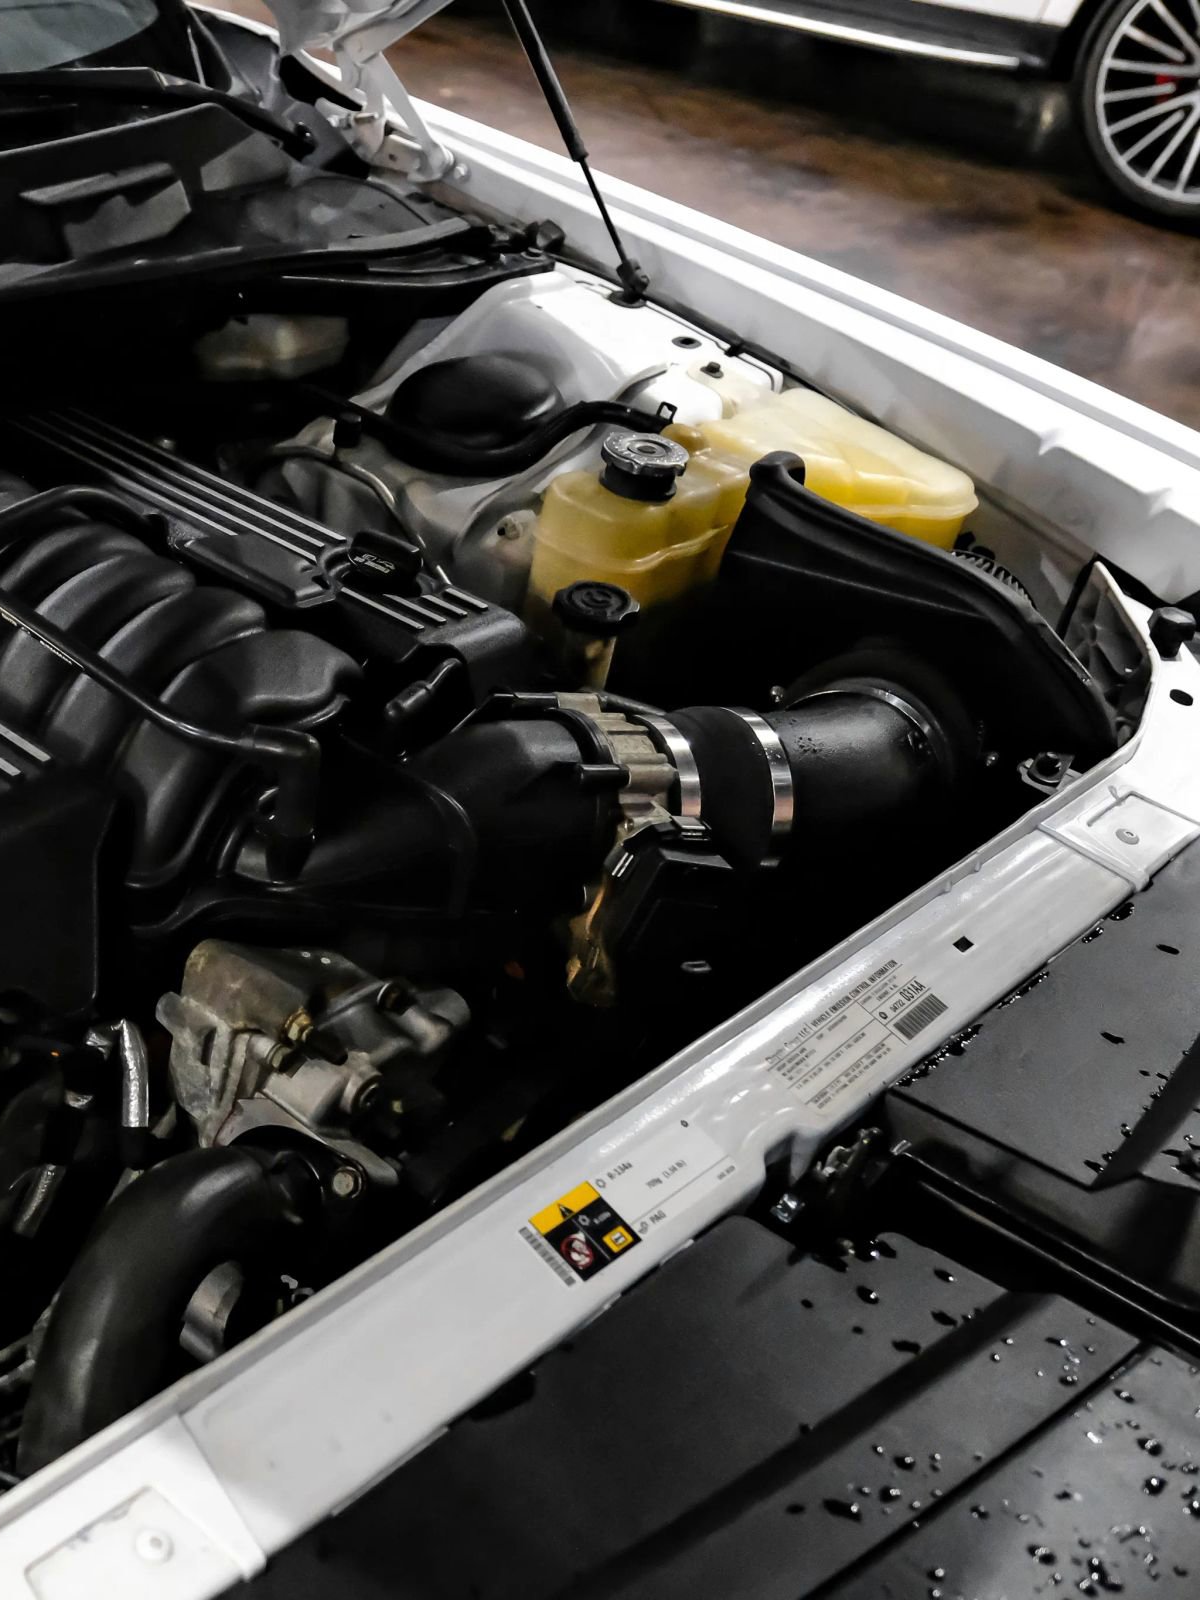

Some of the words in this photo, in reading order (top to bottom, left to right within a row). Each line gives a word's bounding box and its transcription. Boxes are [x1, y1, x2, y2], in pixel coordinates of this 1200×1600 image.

[849, 979, 872, 1000] CONTROL
[899, 980, 926, 1002] 031AA
[649, 1210, 667, 1225] PAG
